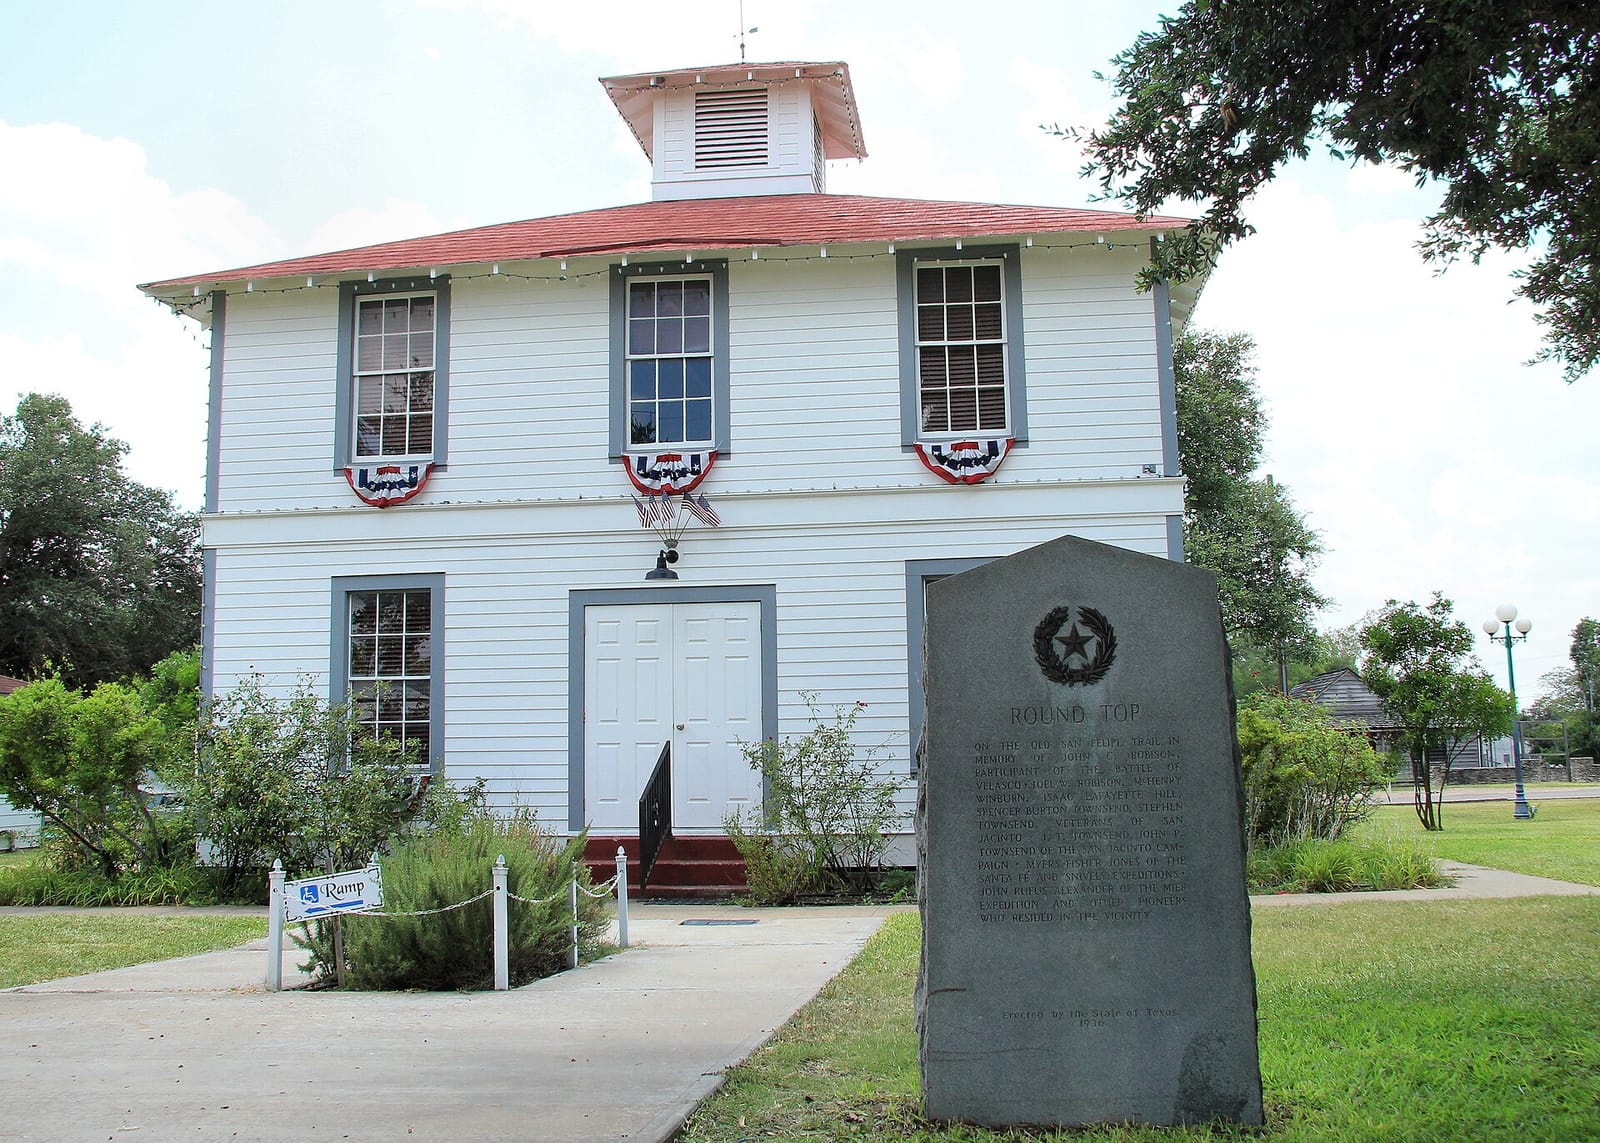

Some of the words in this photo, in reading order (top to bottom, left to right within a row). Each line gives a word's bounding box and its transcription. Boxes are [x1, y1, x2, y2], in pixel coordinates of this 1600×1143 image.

[1011, 706, 1085, 724] ROUND
[1100, 703, 1140, 722] TOP
[975, 742, 988, 751] ON
[1001, 741, 1020, 750] THE
[1030, 740, 1050, 749] OLD
[1061, 740, 1082, 748] SAN
[1132, 737, 1161, 746] TRAIL
[1168, 737, 1180, 745] IN
[975, 755, 1016, 765] MEMORY
[1033, 754, 1045, 762] OF
[1063, 752, 1090, 761] JOHN
[975, 768, 1038, 777] PARTICIPANT
[1053, 767, 1065, 775] OF
[1080, 766, 1101, 774] THE
[1115, 765, 1152, 773] BATTLE
[1167, 763, 1180, 772] OF
[1044, 793, 1073, 801] ISAAC
[1085, 791, 1143, 801] LAFAYETTE
[976, 808, 1021, 817] SPENCER
[1026, 806, 1067, 815] BURTON
[1138, 802, 1183, 812] STEPHEN
[1056, 818, 1113, 827] VETERANS
[1131, 817, 1145, 826] OF
[1163, 816, 1183, 824] SAN
[978, 833, 1022, 843] JACINTO
[1138, 829, 1166, 839] JOHN
[979, 847, 1036, 857] TOWNSEND
[1040, 846, 1052, 855] OF
[1056, 845, 1076, 854] THE
[1081, 845, 1101, 854] SAN
[1108, 843, 1152, 853] JACINTO
[978, 861, 1009, 870] PAIGN
[1026, 859, 1059, 869] MYERS
[1066, 858, 1101, 868] FISHER
[1109, 857, 1140, 867] JONES
[1146, 857, 1159, 865] OF
[1166, 856, 1186, 864] THE
[978, 874, 1012, 884] SANTA
[1037, 873, 1058, 882] AND
[1066, 871, 1105, 881] SNIVELY
[320, 881, 365, 901] Ramp
[980, 887, 1011, 897] JOHN
[1014, 886, 1048, 896] RUFUS
[1054, 884, 1114, 894] ALEXANDER
[1119, 884, 1132, 893] OF
[1138, 883, 1157, 892] THE
[980, 900, 1039, 911] EXPEDITION
[1053, 899, 1074, 909] AND
[1138, 896, 1187, 906] PIONEERS
[980, 914, 1004, 923] WHO
[1012, 913, 1053, 922] RESIDED
[1059, 912, 1070, 921] IN
[1078, 911, 1098, 921] THE
[1002, 1011, 1044, 1020] Erected
[1052, 1010, 1064, 1019] by
[1070, 1010, 1088, 1018] the
[1092, 1009, 1121, 1018] State
[1126, 1008, 1137, 1017] of
[1146, 1008, 1177, 1017] Texas
